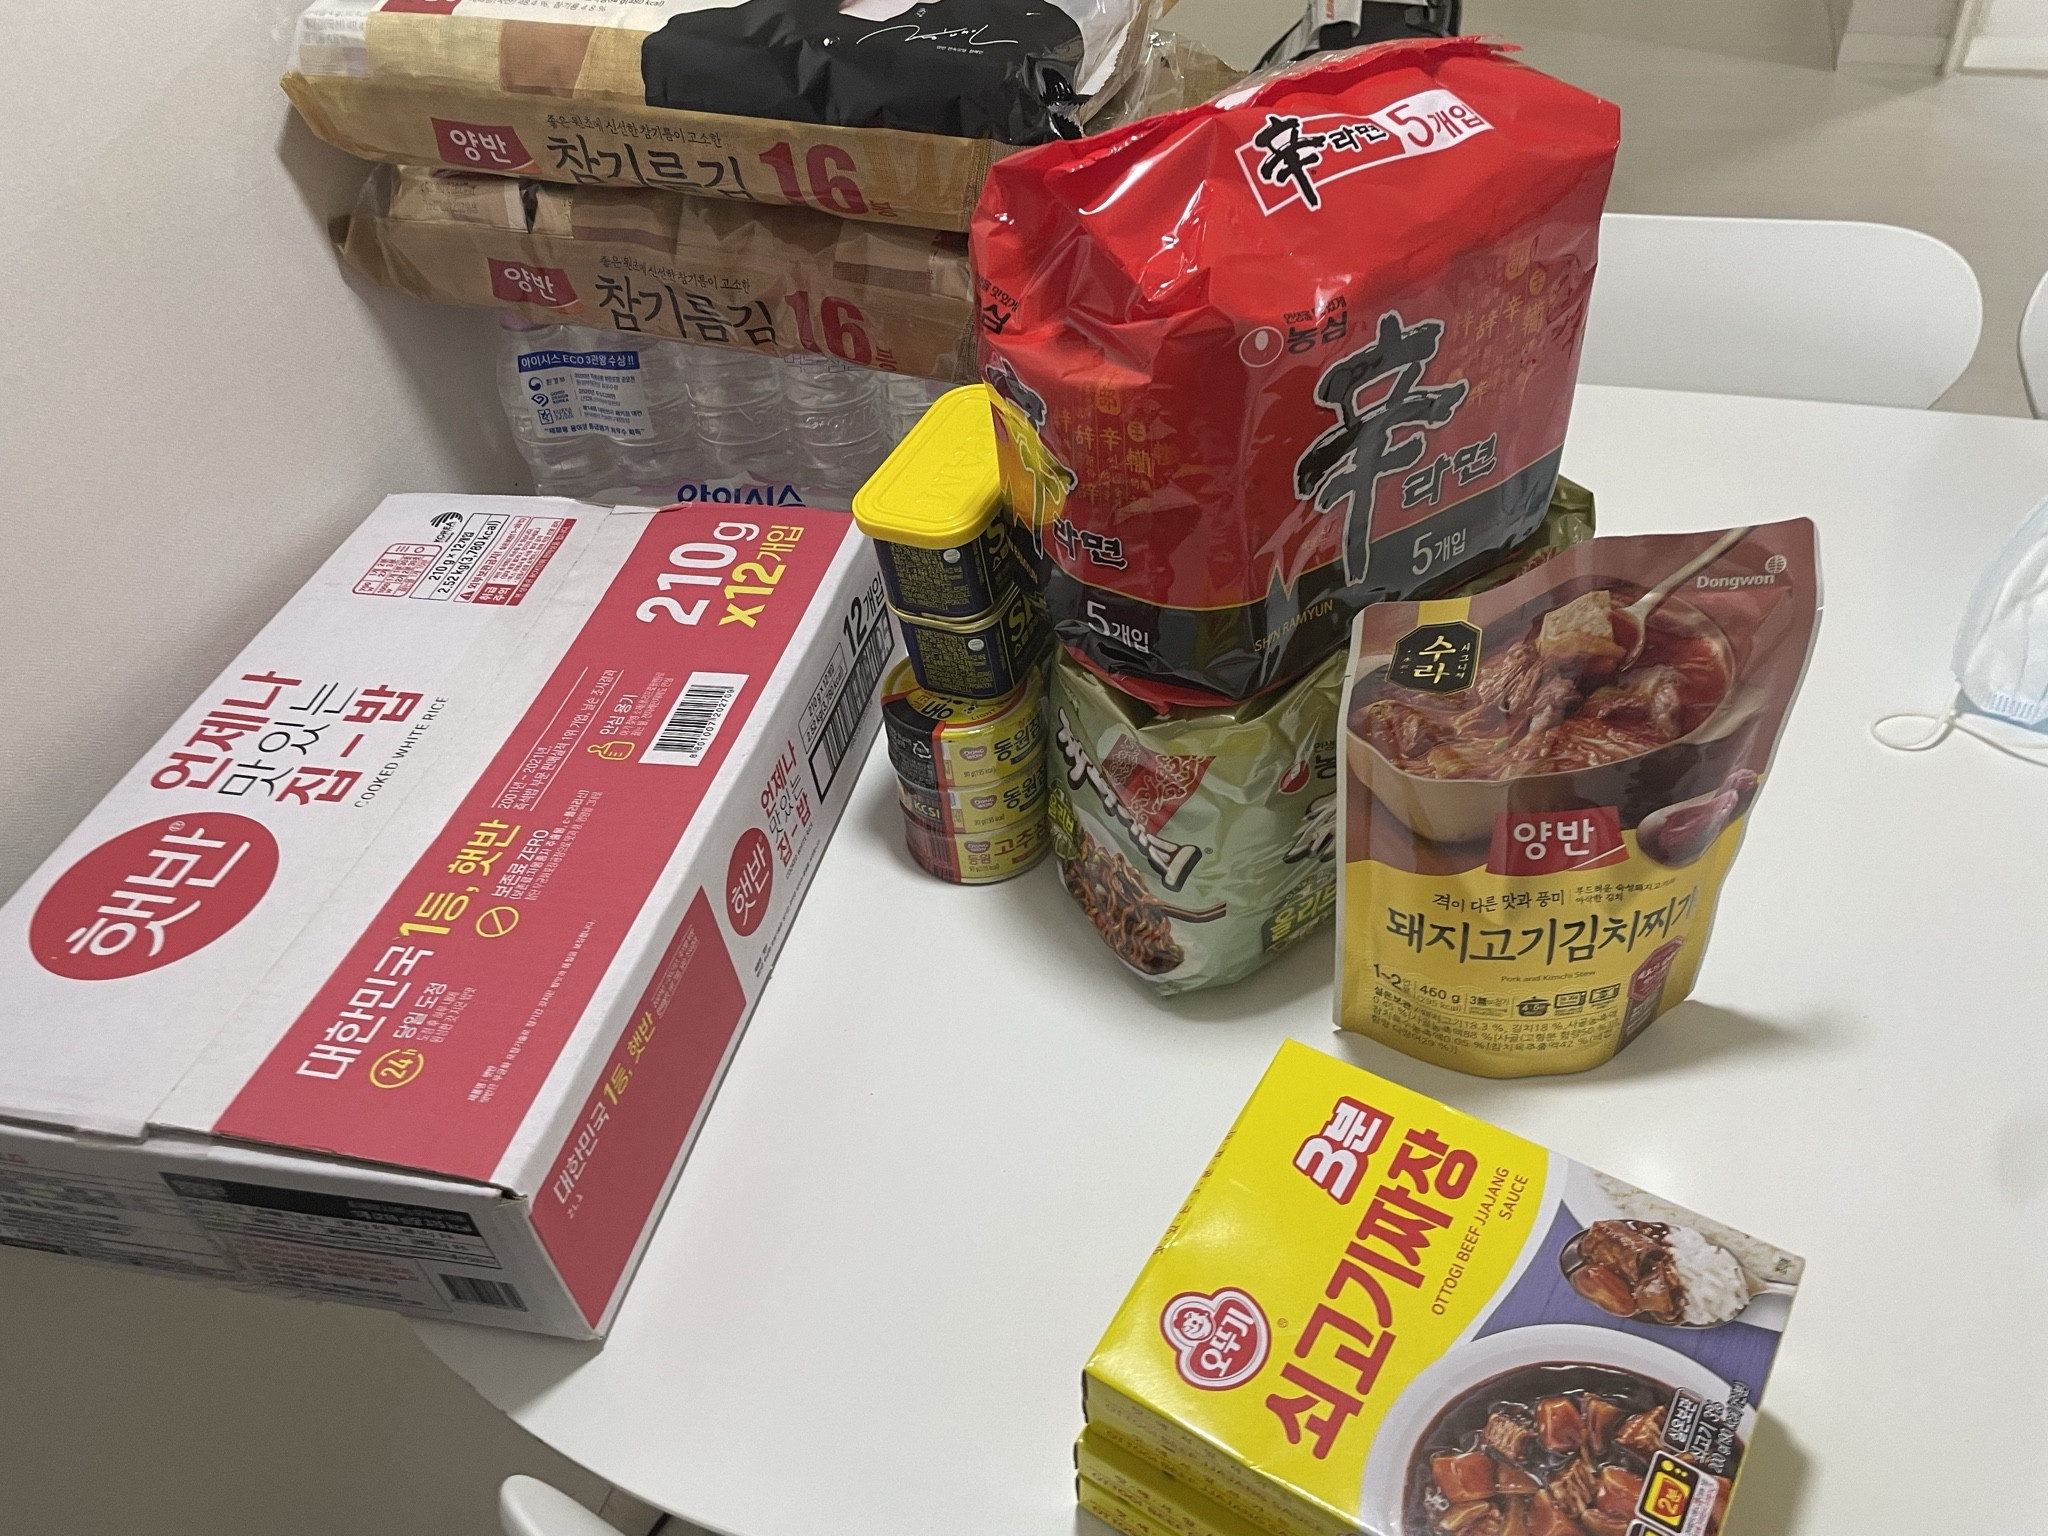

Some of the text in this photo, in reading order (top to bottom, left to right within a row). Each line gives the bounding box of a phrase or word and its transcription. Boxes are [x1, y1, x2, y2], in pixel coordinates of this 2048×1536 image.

[450, 129, 511, 163] 양반
[606, 118, 639, 137] 신선한
[640, 124, 685, 143] 참기름이
[687, 131, 722, 147] 고소한
[1254, 103, 1485, 208] 辛 라면 5개입
[504, 267, 554, 300] 양반
[648, 264, 677, 283] 신선한
[678, 272, 718, 290] 참기름이
[720, 274, 750, 294] 고소한
[595, 274, 778, 346] 참기름김
[1287, 311, 1347, 354] 농심
[521, 355, 561, 369] 아이시스
[563, 354, 584, 365] ECO
[586, 355, 607, 366] 3관왕
[608, 355, 626, 366] 수상
[1295, 310, 1468, 586] 辛
[1402, 433, 1498, 508] 라면
[427, 565, 448, 580] 210
[445, 531, 475, 552] 12개입
[436, 520, 505, 593] 2.52 kg(3,780 kcal)
[637, 522, 758, 624] 210g
[1412, 532, 1466, 576] 5개입
[1696, 574, 1776, 591] Dongwon
[478, 586, 498, 600] 취급
[492, 586, 511, 601] 주의
[843, 571, 886, 656] 12개입
[1087, 600, 1150, 653] 5개입
[1254, 600, 1334, 652] SHIN RAMYUN
[151, 671, 299, 789] 언제나
[599, 693, 637, 734] 안심 용기
[712, 688, 734, 717] 202709
[218, 683, 367, 796] 맛있는
[353, 696, 446, 807] COOKED WHITE RICE
[512, 669, 617, 810] 즉석밥 부문 판매실적 1위 기업, 닐슨 조사결과
[497, 745, 552, 809] 2001년 2021년,
[760, 740, 796, 818] 언제나
[769, 763, 803, 842] 맛있는
[913, 801, 940, 820] KCSI
[491, 829, 549, 897] 보존료 ZERO
[1513, 817, 1596, 862] 양반
[69, 825, 248, 955] 햇반
[731, 843, 769, 925] 햇반
[1432, 889, 1564, 913] 격이 다른 맛과 풍미
[1575, 883, 1612, 896] 부드러운
[1575, 892, 1624, 905] 아삭한 김치
[297, 819, 520, 1079] 대한민국 1등, 햇반
[1501, 975, 1521, 983] Pork
[1543, 972, 1574, 981] Kimchi
[1574, 970, 1596, 978] Stew
[392, 982, 447, 1039] 당일 도정
[1419, 985, 1447, 1000] 460
[1451, 993, 1461, 1004] g
[553, 1011, 655, 1203] 대한민국 1등, 햇반
[1293, 1101, 1384, 1204] 3분
[1498, 1174, 1528, 1220] SAUCE
[1431, 1167, 1509, 1315] OTTOGI BEEF JJAJANG
[1265, 1129, 1478, 1460] 쇠고기짜장
[1200, 1307, 1257, 1378] 오뚜기
